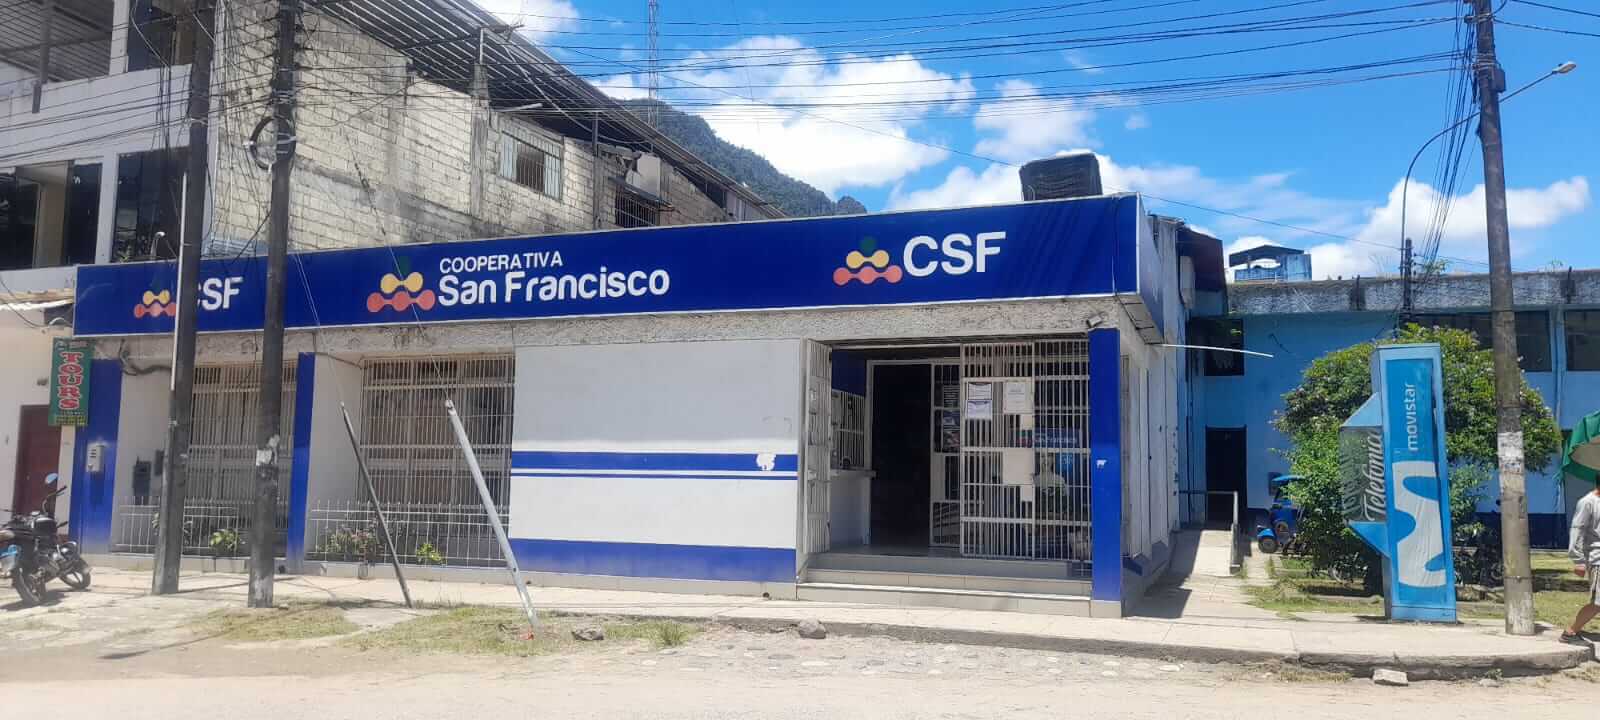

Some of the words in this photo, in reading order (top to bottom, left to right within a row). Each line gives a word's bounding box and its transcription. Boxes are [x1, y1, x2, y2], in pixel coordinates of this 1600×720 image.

[439, 251, 563, 274] COOPERATIVA
[903, 231, 1006, 277] CSF
[197, 276, 243, 311] SF
[438, 274, 497, 307] San
[504, 266, 671, 303] Francisco
[58, 351, 84, 410] TOURS
[1403, 383, 1419, 452] movistar
